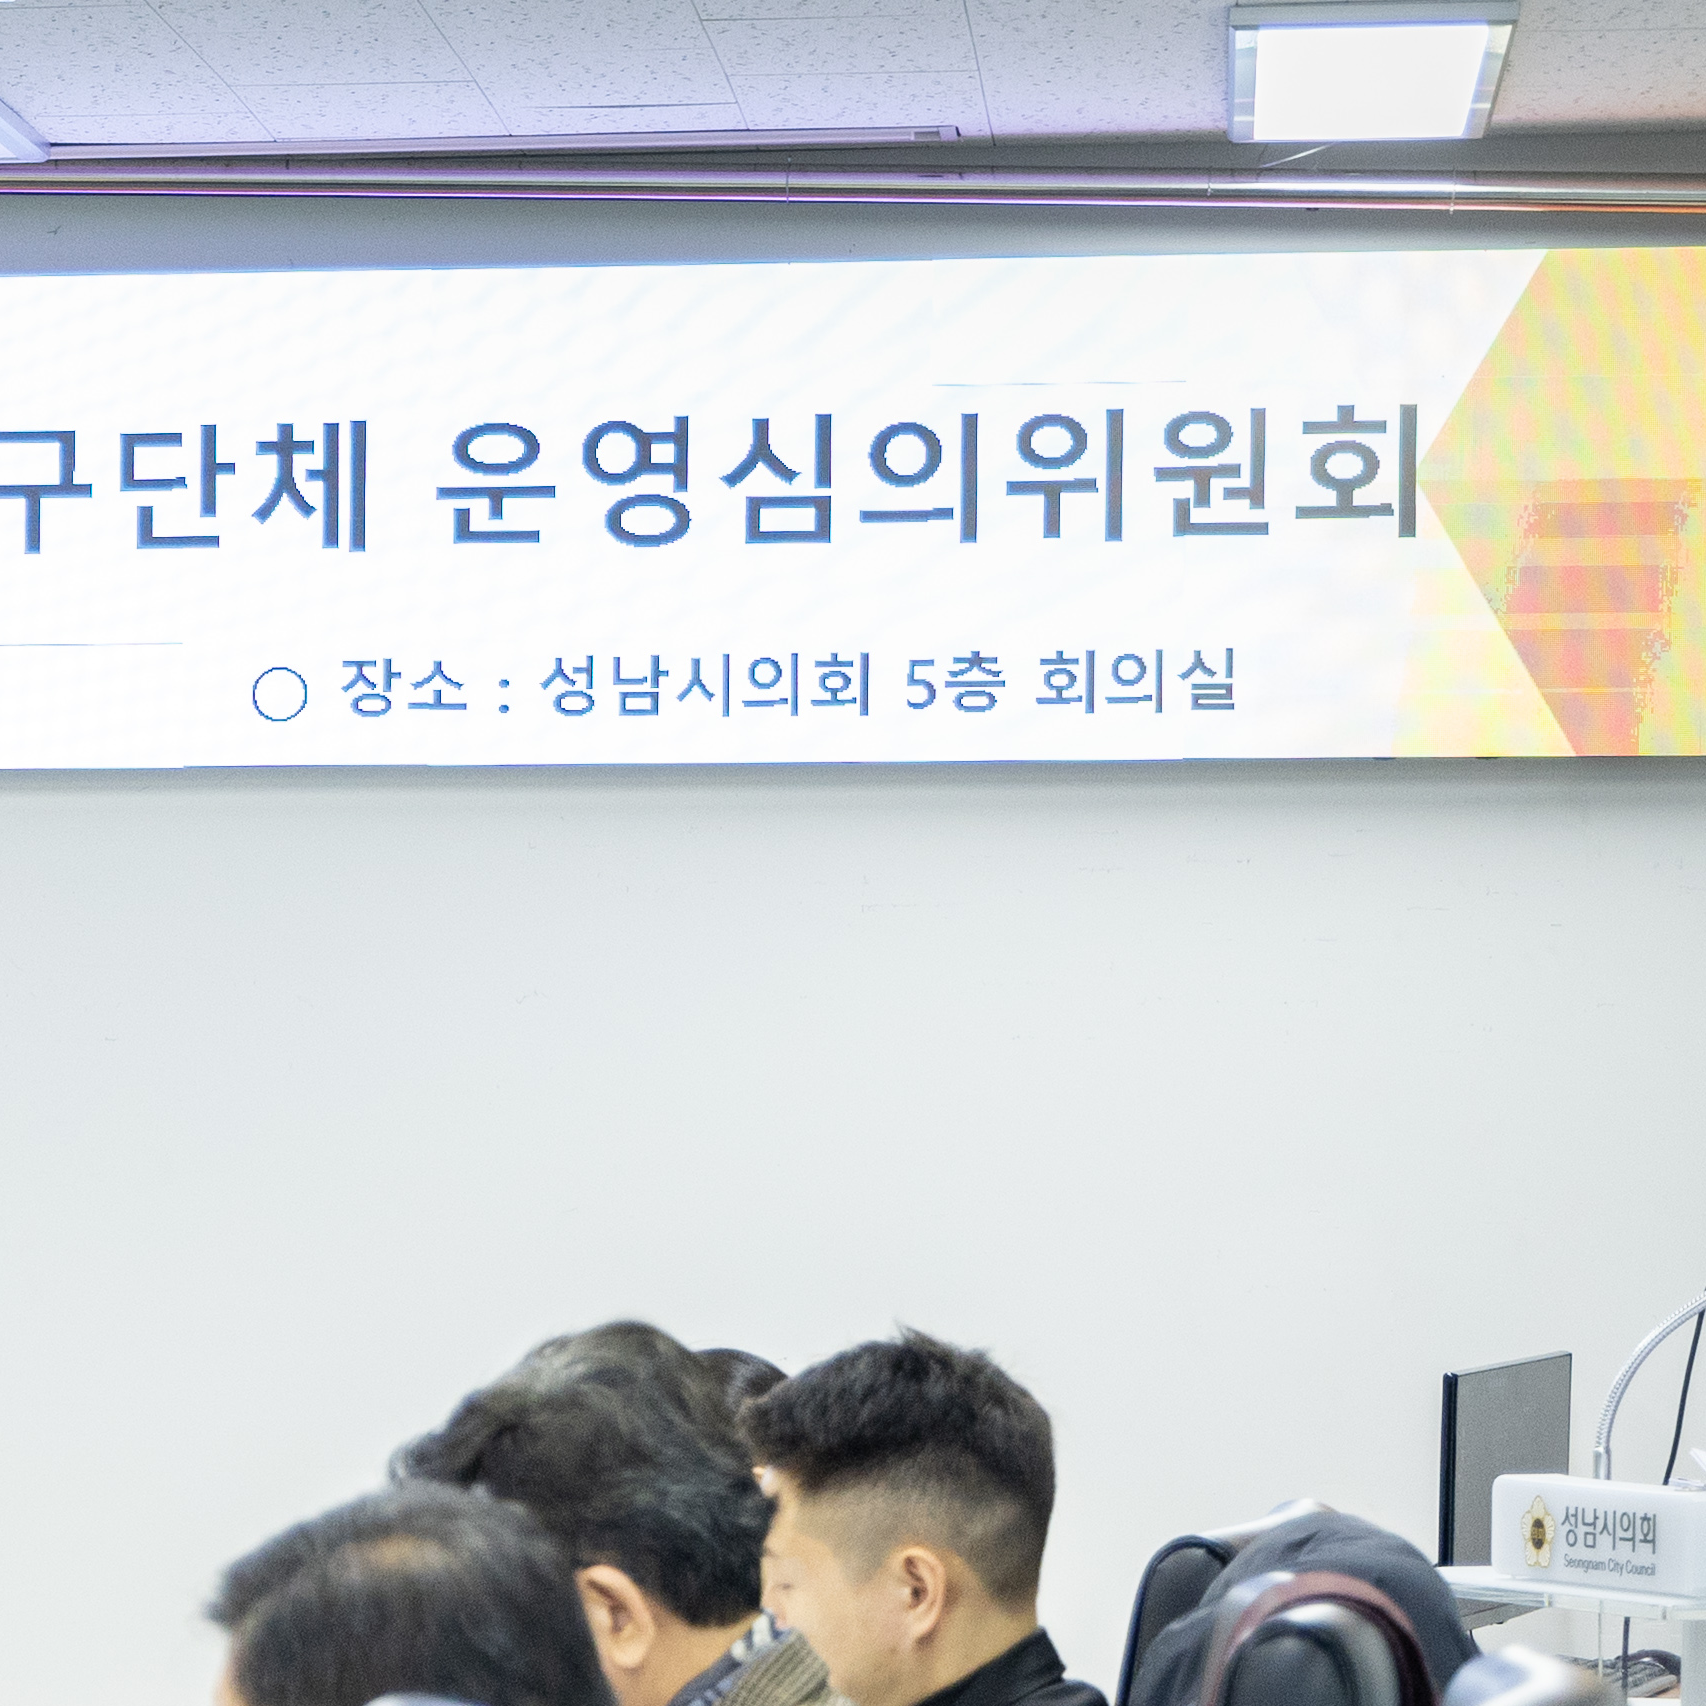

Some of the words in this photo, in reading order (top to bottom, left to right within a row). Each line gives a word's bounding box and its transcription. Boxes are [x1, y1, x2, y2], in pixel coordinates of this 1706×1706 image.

[435, 403, 1418, 549] 운영심의위원회
[341, 657, 468, 718] 장소
[540, 651, 870, 718] 성남시의회
[906, 650, 1006, 714] 5층
[1035, 647, 1236, 715] 회의실
[1561, 1506, 1656, 1555] 성남시의회
[1564, 1553, 1606, 1573] Seongnam
[1608, 1557, 1624, 1576] City
[1625, 1560, 1656, 1576] Council
